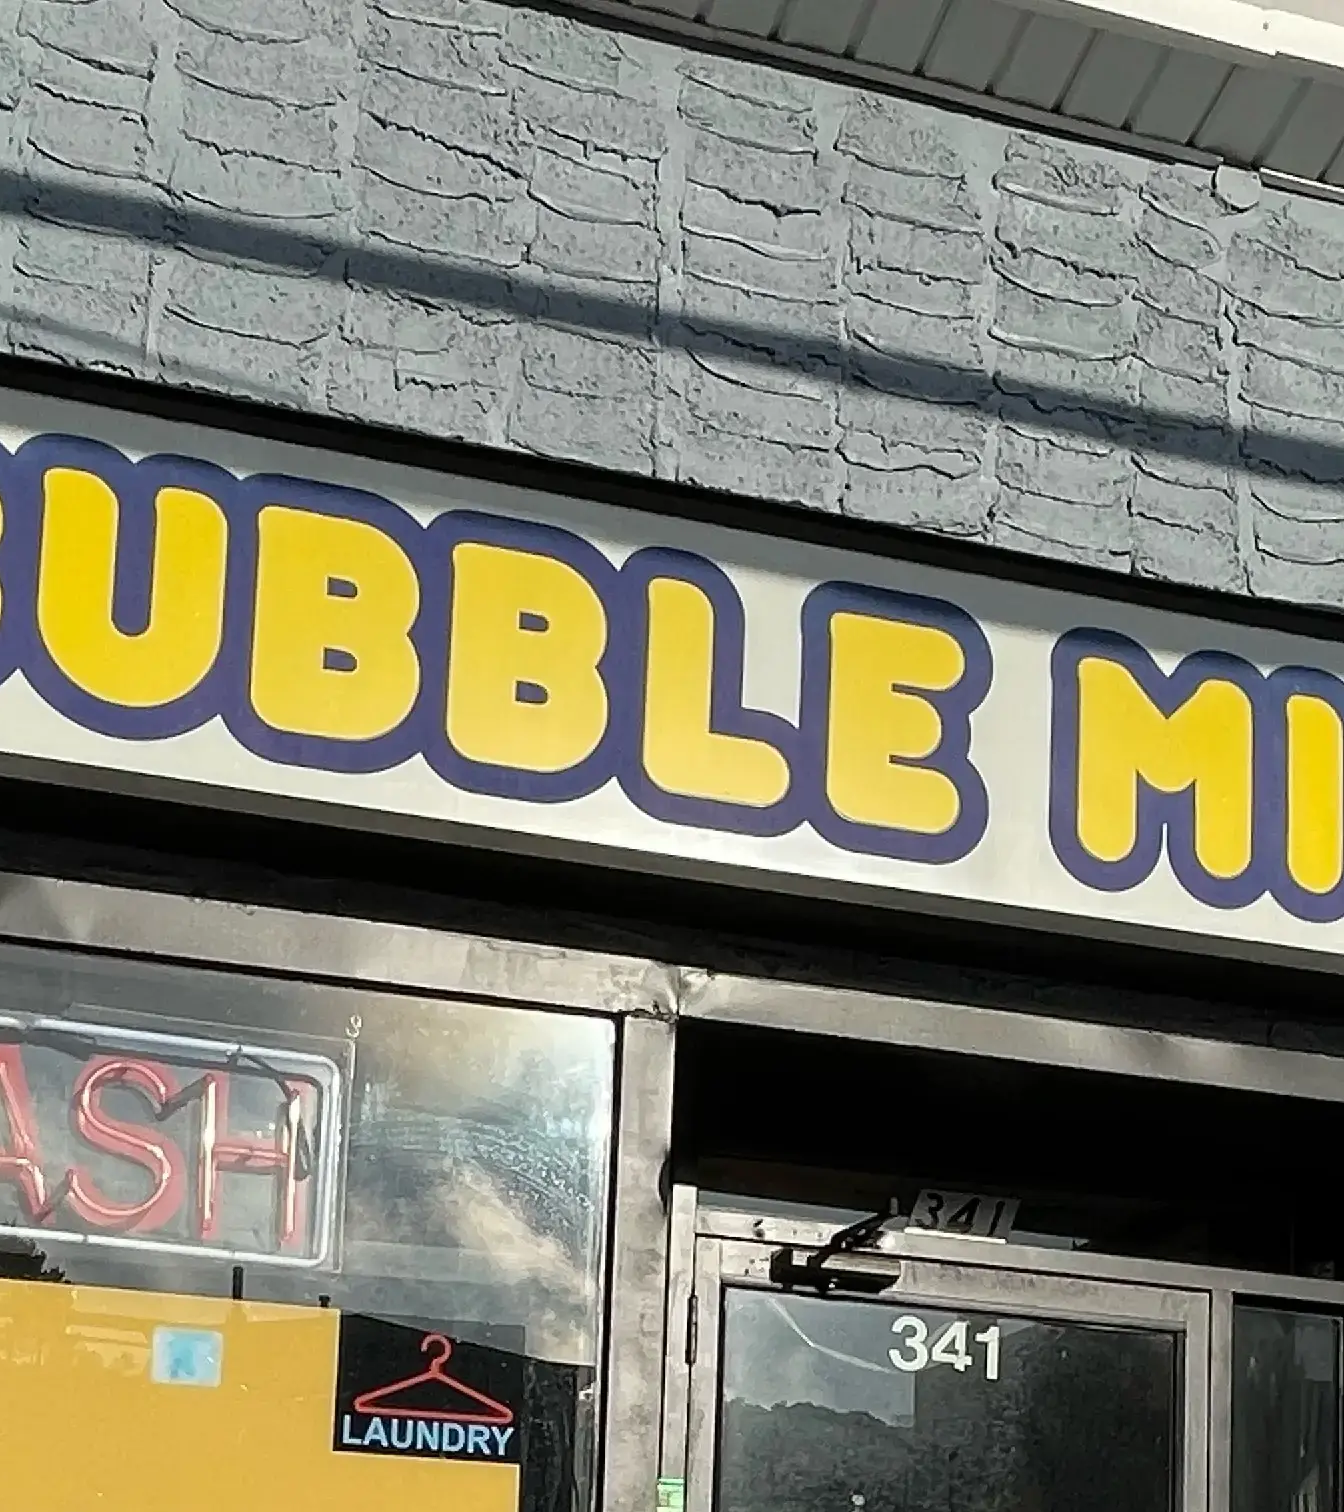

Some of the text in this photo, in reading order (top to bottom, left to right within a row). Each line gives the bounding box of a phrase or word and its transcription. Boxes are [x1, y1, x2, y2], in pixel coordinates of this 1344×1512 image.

[915, 1192, 1006, 1237] 341
[888, 1314, 1001, 1381] 341
[341, 1413, 516, 1456] LAUNDRY
